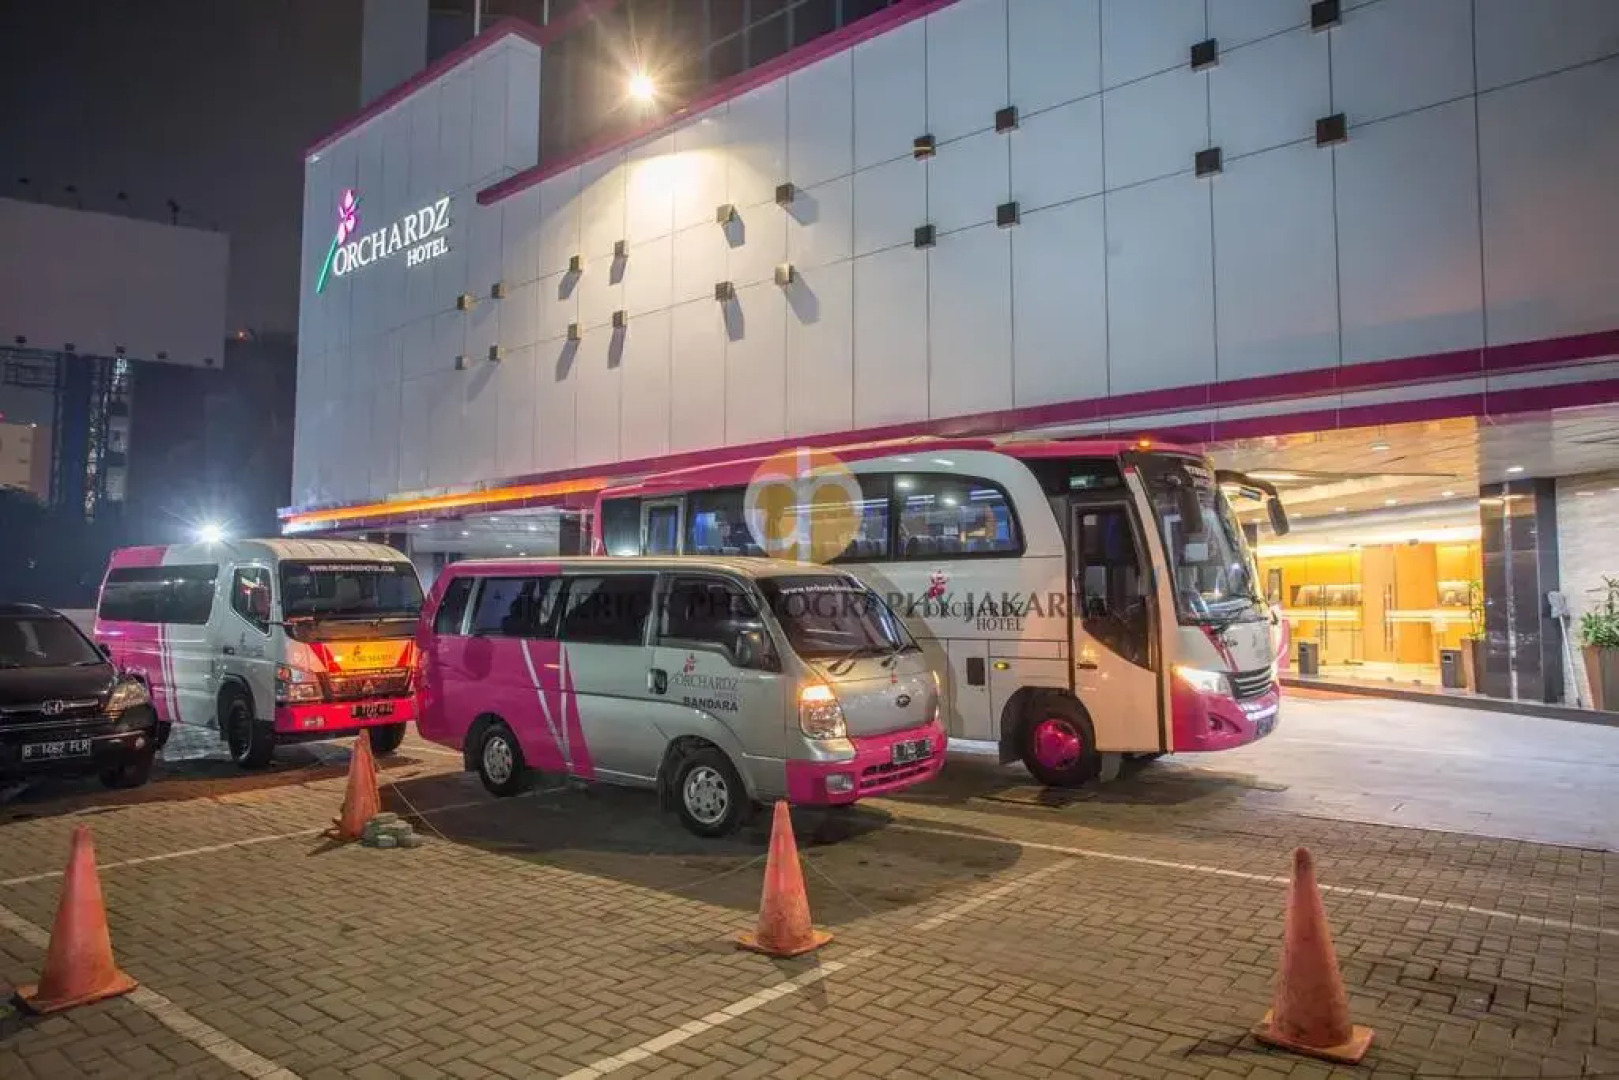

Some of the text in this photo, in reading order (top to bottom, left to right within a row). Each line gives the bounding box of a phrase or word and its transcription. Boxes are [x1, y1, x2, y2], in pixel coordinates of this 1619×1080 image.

[333, 196, 450, 276] ORCHARDZ
[407, 237, 448, 267] HOTEL
[976, 617, 1025, 632] HOTEL
[676, 674, 739, 690] ORCHARDZ
[683, 697, 738, 711] BANDARA
